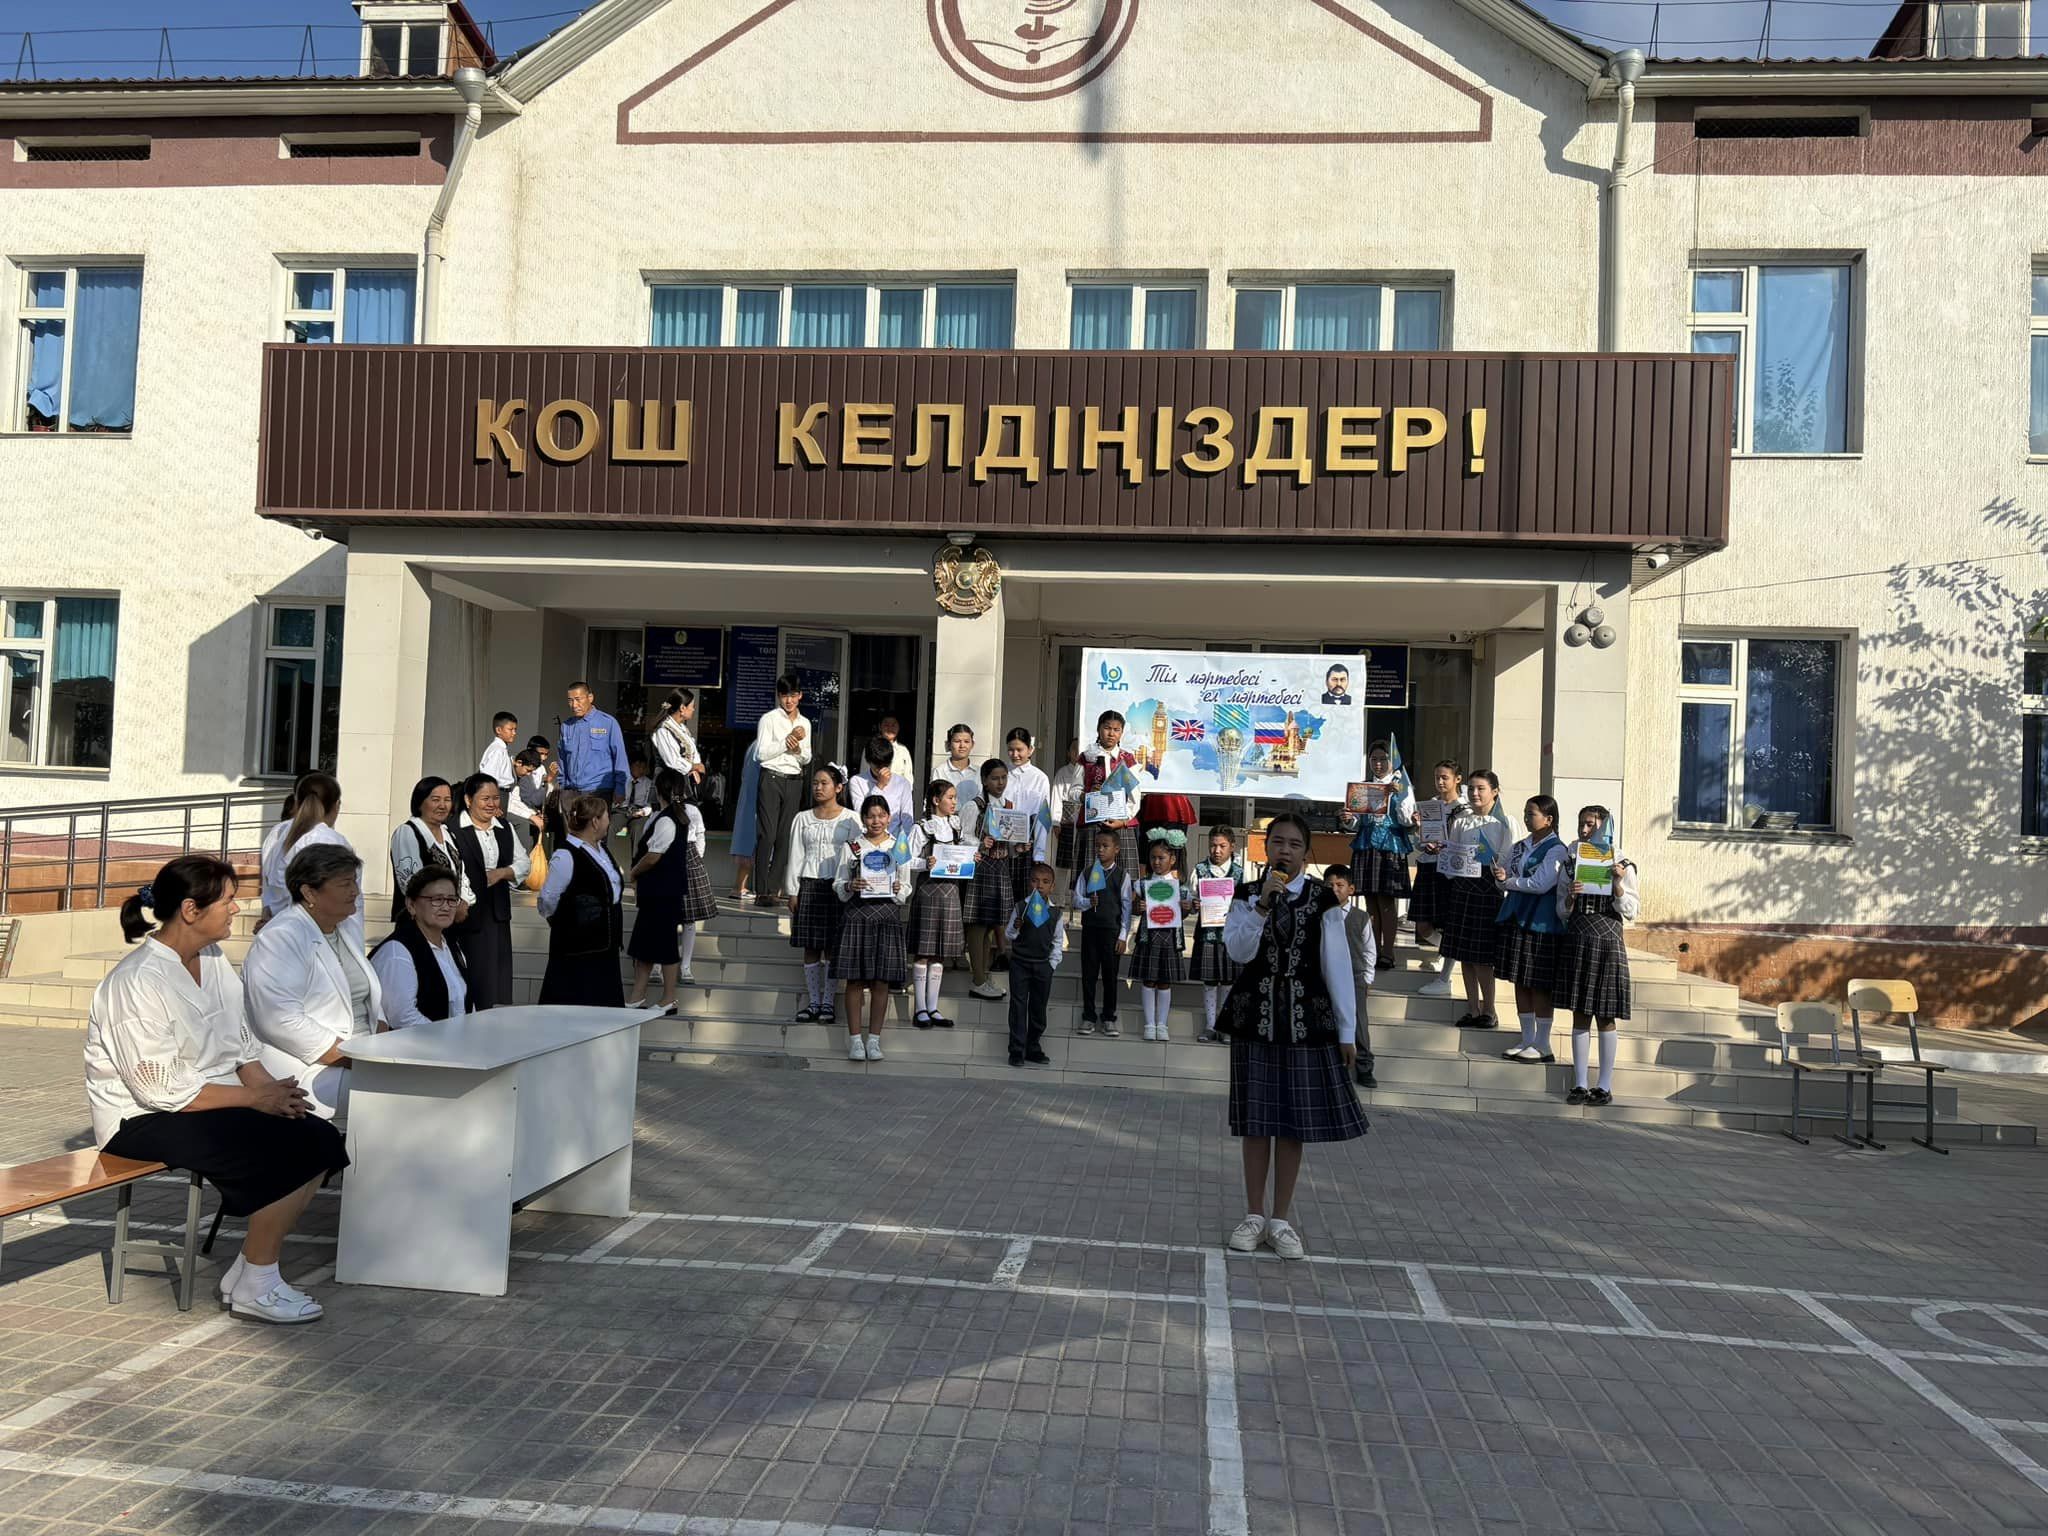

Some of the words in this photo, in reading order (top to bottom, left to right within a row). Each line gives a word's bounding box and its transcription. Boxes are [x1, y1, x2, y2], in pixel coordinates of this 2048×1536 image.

[475, 398, 692, 475] ҚОШ
[1145, 664, 1178, 683] Тіл
[1186, 669, 1263, 690] мәртебесі
[1202, 691, 1219, 703] ел
[1227, 688, 1305, 709] мәртебесі
